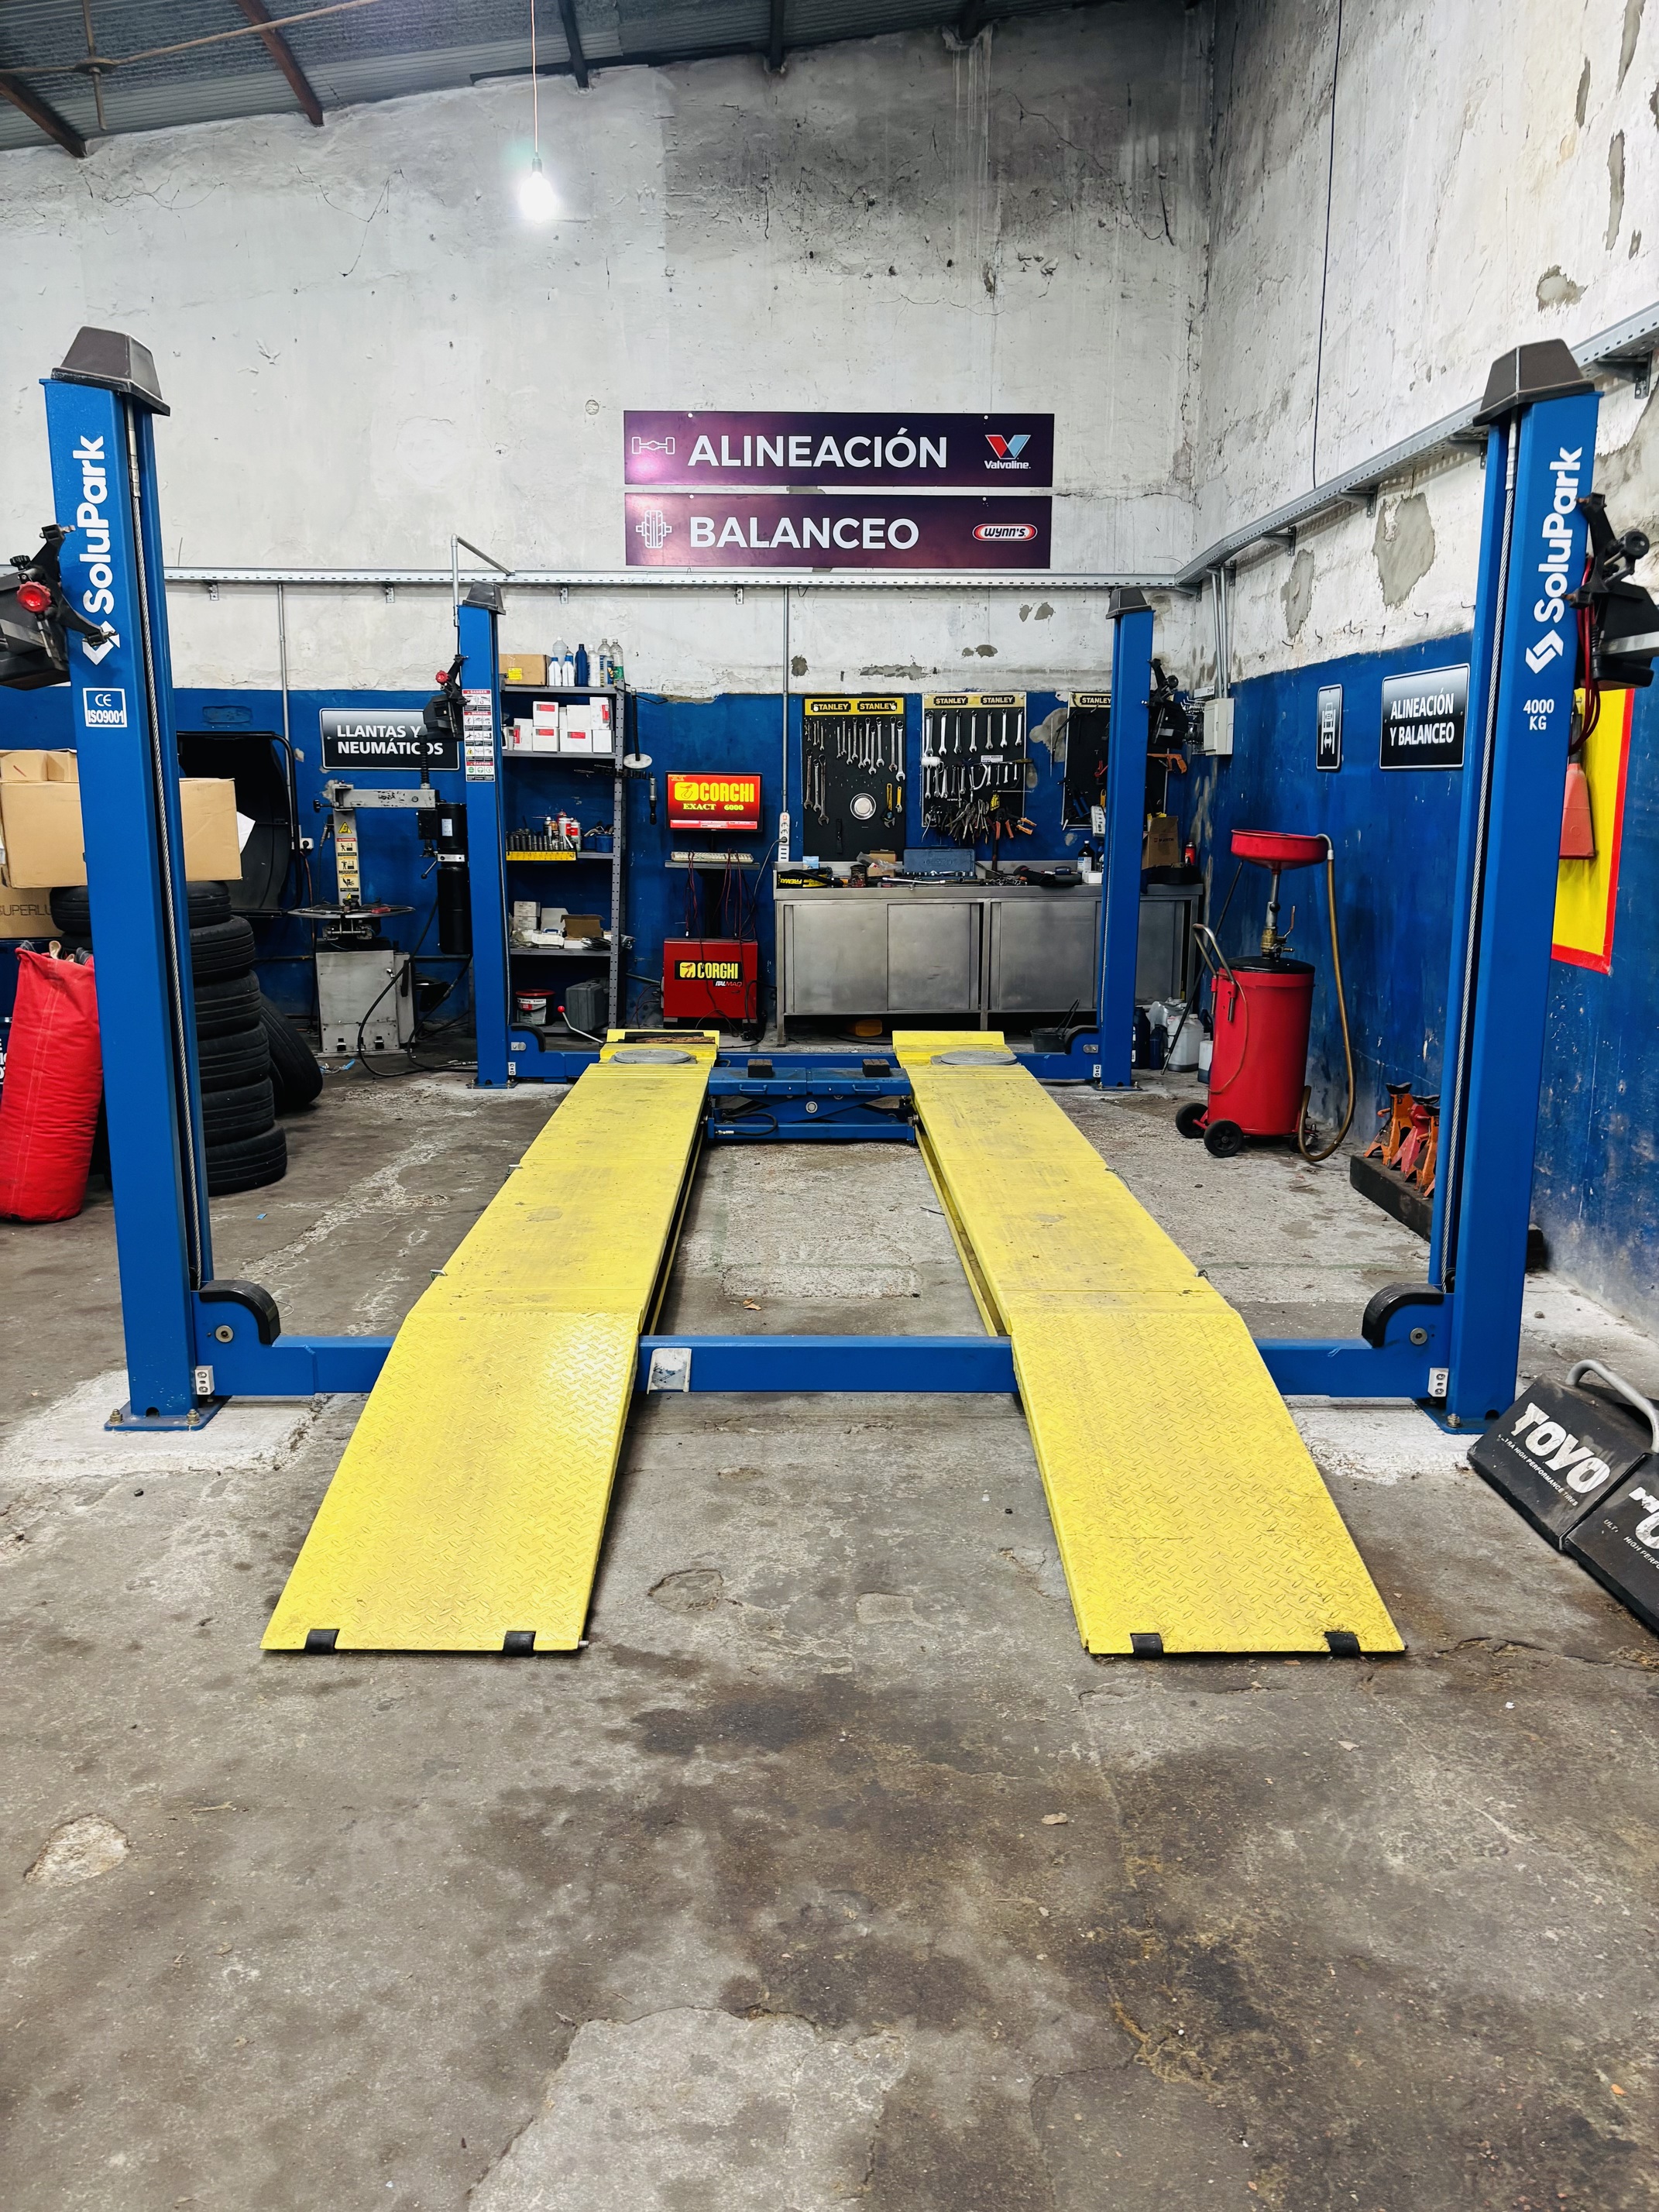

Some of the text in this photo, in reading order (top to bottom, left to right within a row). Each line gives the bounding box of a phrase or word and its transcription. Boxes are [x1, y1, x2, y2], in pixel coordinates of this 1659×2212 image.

[688, 427, 947, 468] ALINEACIÓN
[73, 434, 115, 615] SoluPark
[689, 516, 919, 550] BALANCEO
[1534, 446, 1583, 623] SoluPark
[94, 693, 112, 707] CE
[1390, 687, 1455, 720] ALINEACIÓN
[1523, 699, 1555, 714] 4000
[88, 709, 124, 724] ISO9001
[1529, 716, 1547, 730] KG
[337, 724, 422, 738] LLANTAS Y
[1389, 721, 1455, 746] Y BALANCEO
[699, 782, 755, 802] CORGHI
[697, 962, 739, 979] CORGHI
[1510, 1402, 1611, 1494] TOYO
[1513, 1447, 1528, 1460] HIGH
[1525, 1458, 1565, 1493] PERFORMANCE
[1623, 1536, 1643, 1551] HIGH
